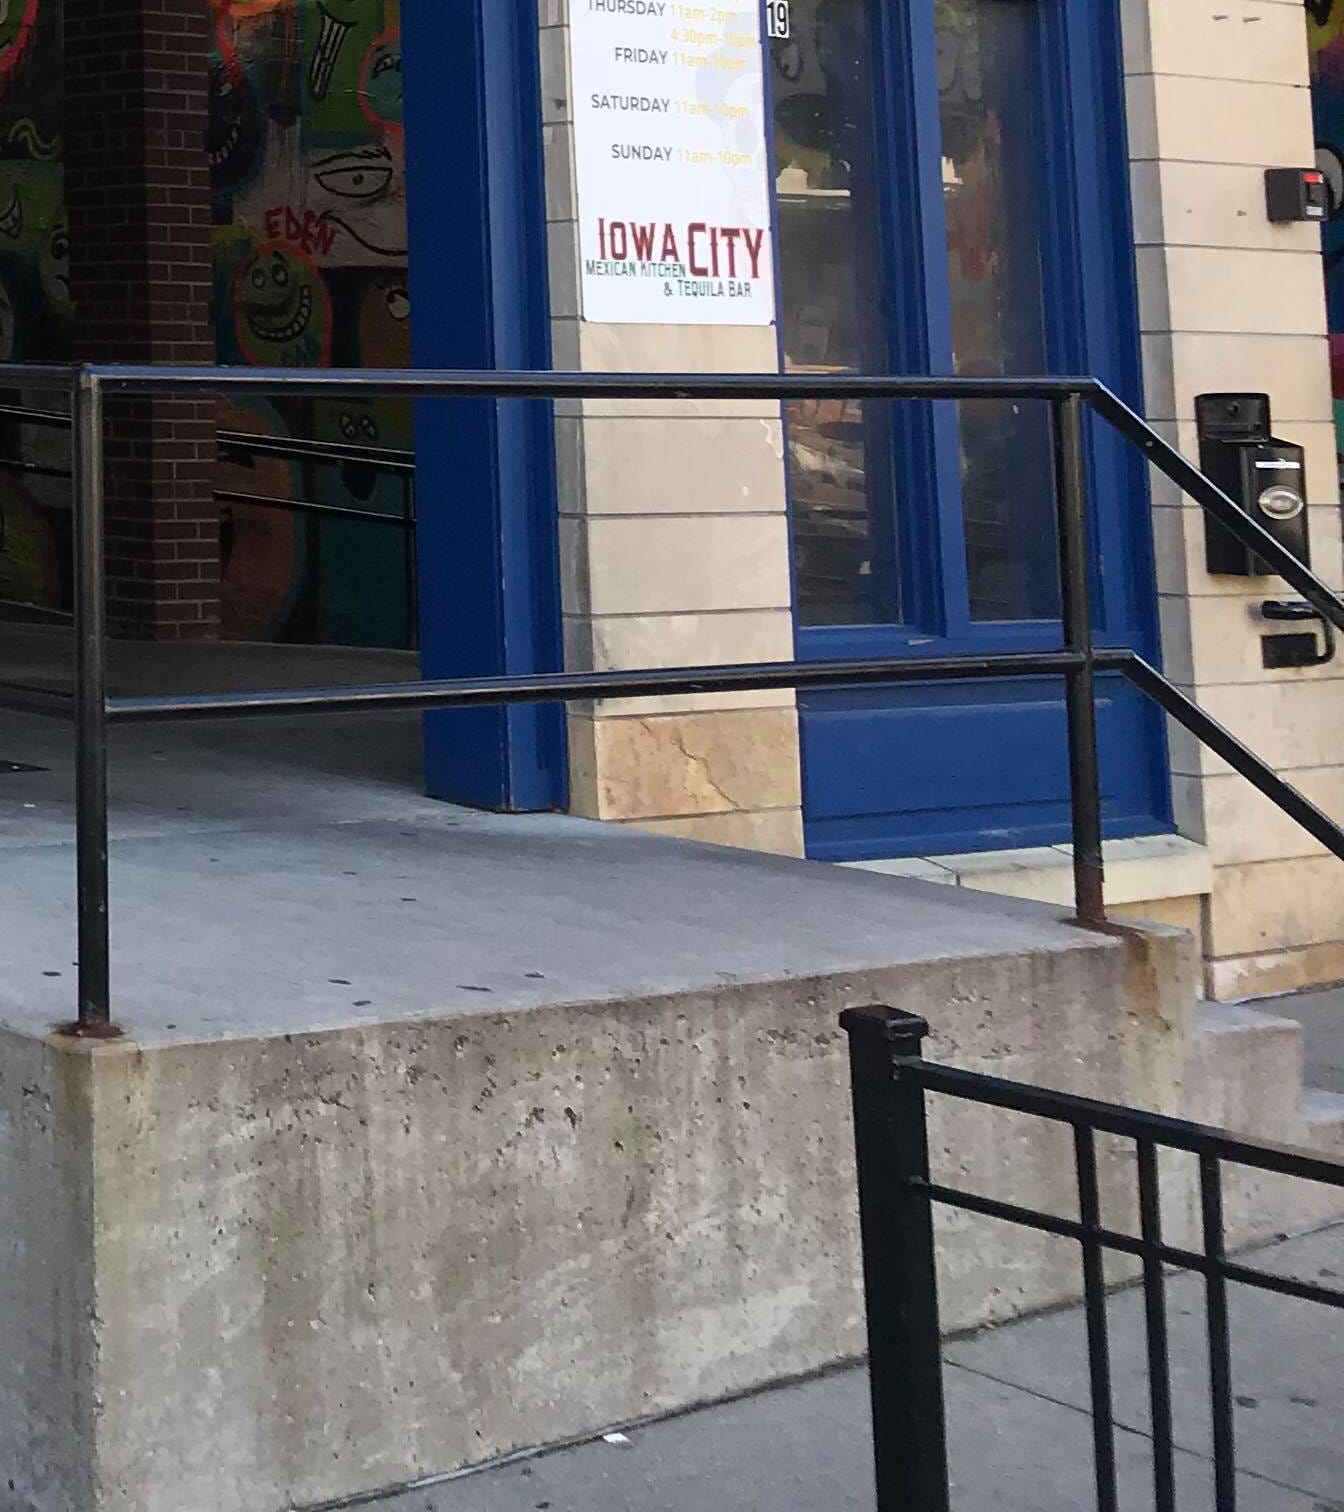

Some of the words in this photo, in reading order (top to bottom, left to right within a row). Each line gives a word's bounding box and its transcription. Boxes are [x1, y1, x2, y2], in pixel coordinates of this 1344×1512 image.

[614, 47, 668, 65] FRIDAY
[590, 94, 671, 114] SATURDAY
[611, 144, 673, 162] SUNDAY
[598, 217, 681, 263] IOWA
[687, 222, 765, 279] CITY
[585, 259, 637, 276] MEXICAN
[640, 260, 686, 278] KITCHEN
[663, 281, 673, 296] &
[677, 279, 724, 298] TEQUILA
[728, 280, 752, 298] BAR
